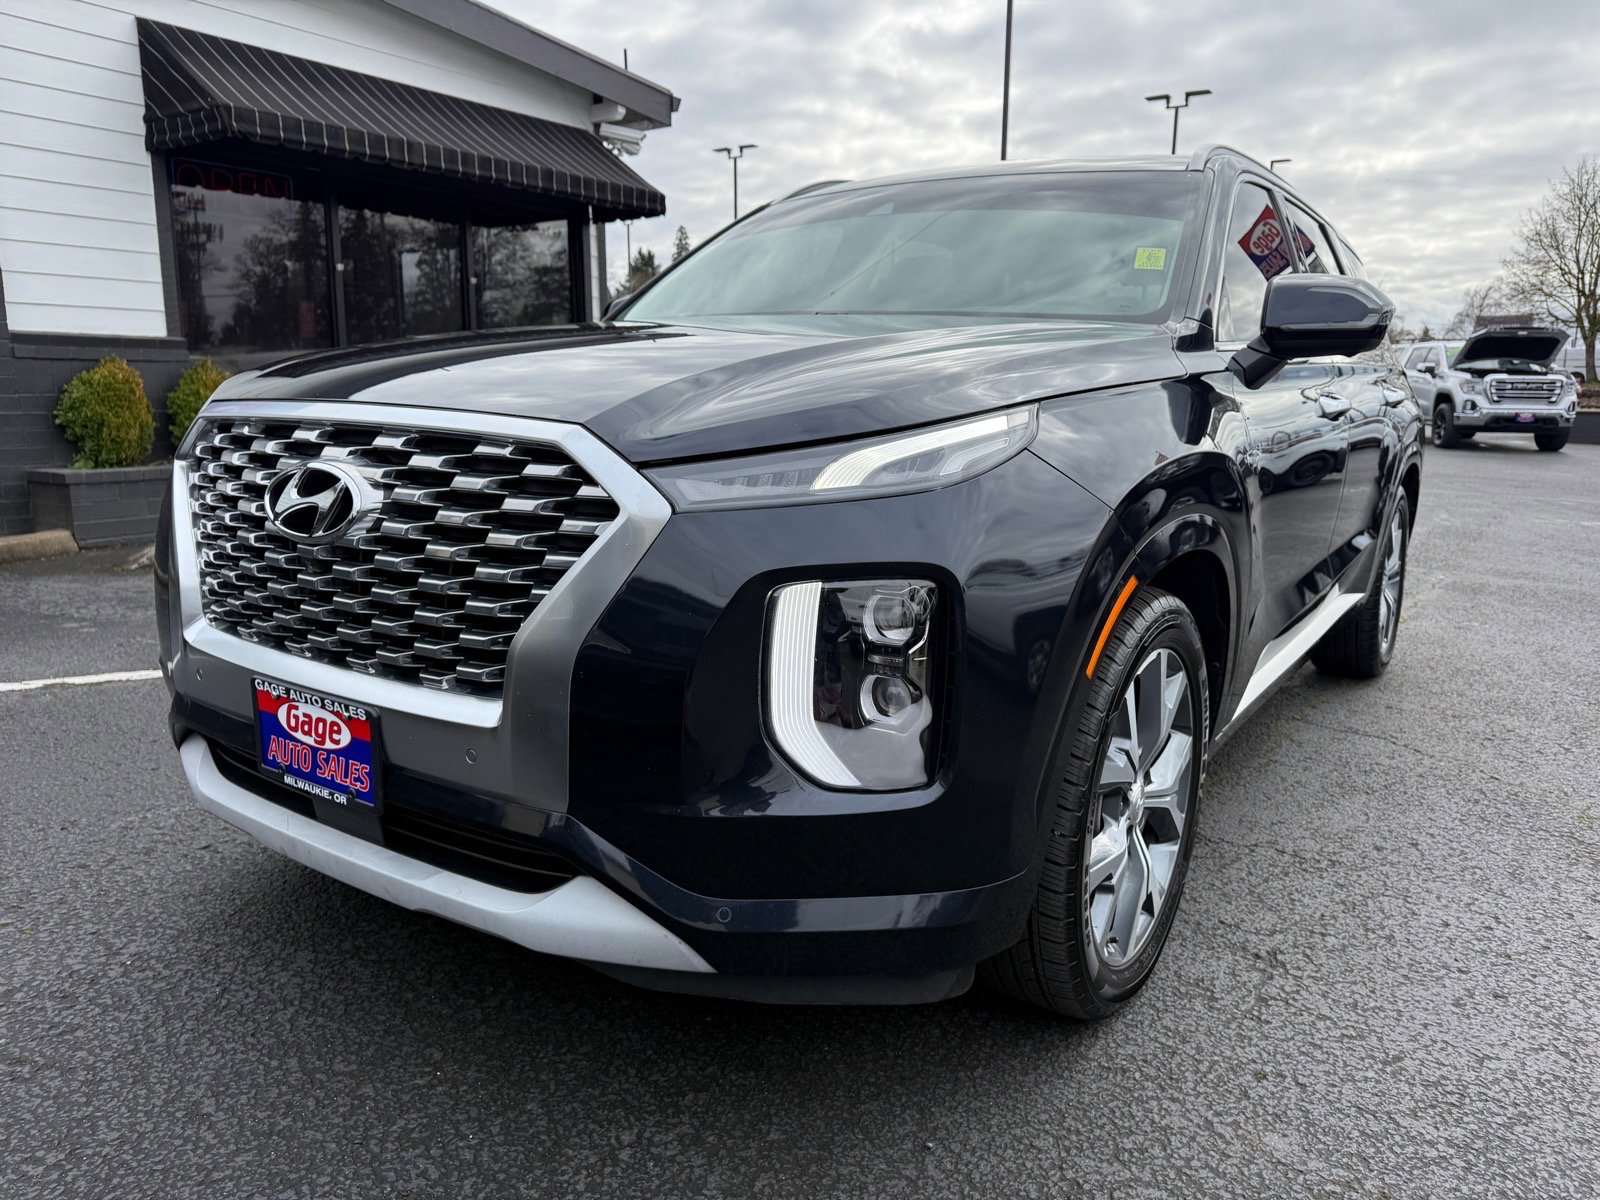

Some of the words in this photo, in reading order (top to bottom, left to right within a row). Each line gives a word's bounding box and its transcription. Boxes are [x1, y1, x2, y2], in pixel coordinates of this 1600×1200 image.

[254, 679, 286, 698] GAGE
[289, 689, 322, 706] AUTO
[324, 699, 367, 721] SALES
[285, 703, 342, 747] Gage
[267, 735, 312, 773] AUTO
[316, 751, 370, 793] SALES
[333, 793, 347, 806] OR
